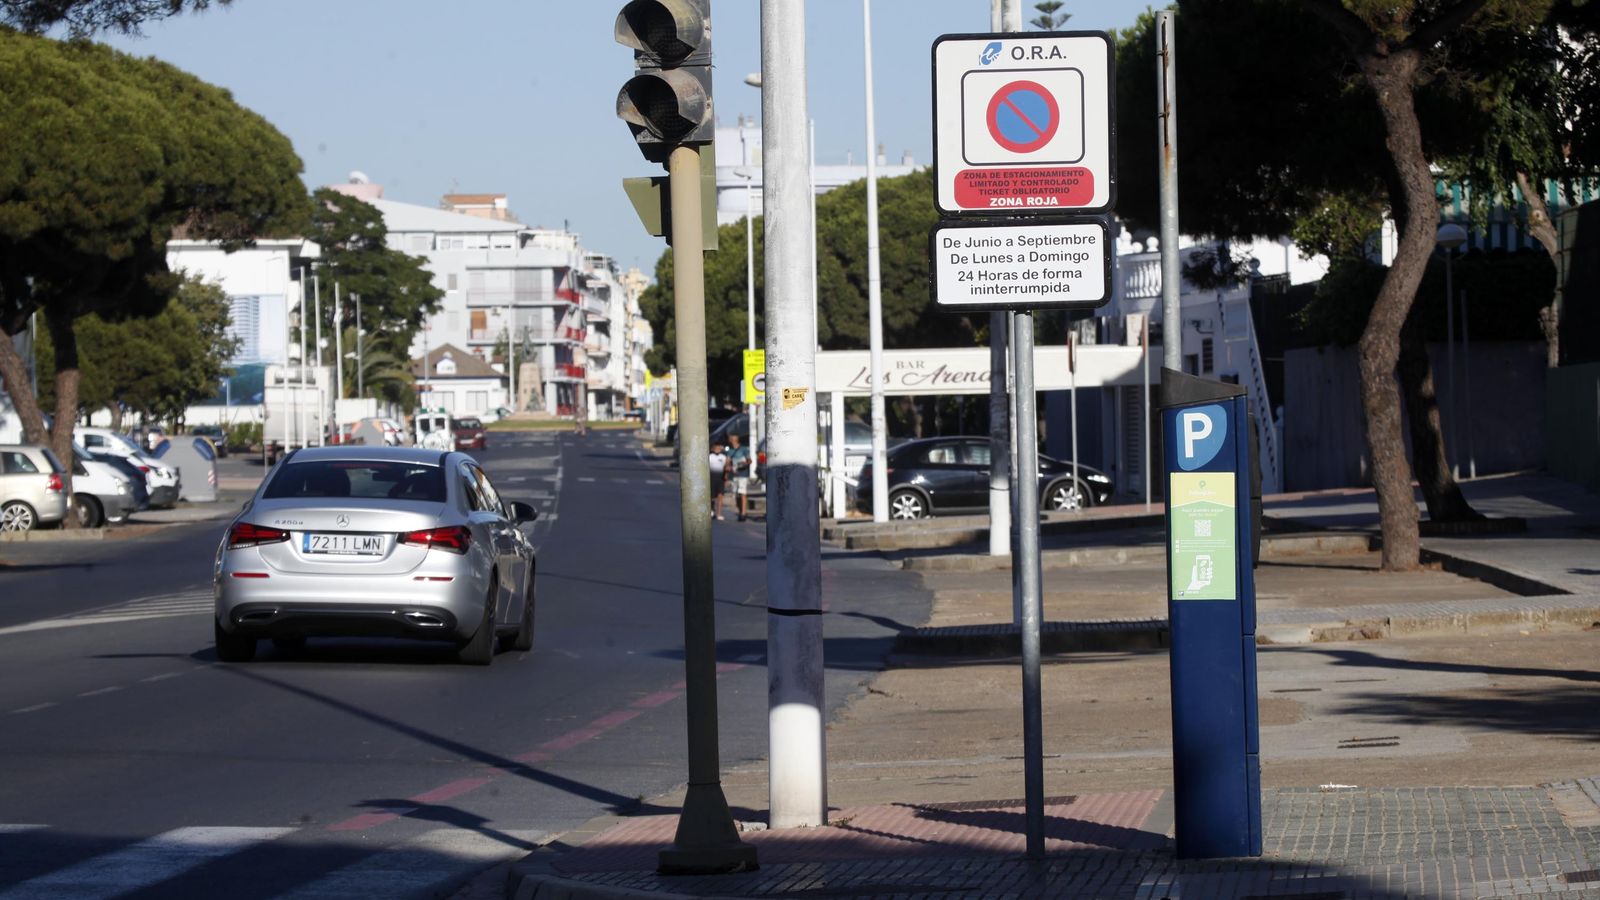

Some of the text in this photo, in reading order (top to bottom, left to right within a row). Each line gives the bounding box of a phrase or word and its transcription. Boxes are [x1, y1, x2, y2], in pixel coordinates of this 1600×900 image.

[1010, 45, 1067, 60] O.R.A.
[989, 171, 1001, 179] DE
[1003, 170, 1085, 178] ESTACIONAMIENTO
[969, 179, 1010, 187] LIMITADO
[1020, 178, 1079, 187] CONTROLADO
[979, 186, 1070, 195] TICKET OBLIGATORIO
[989, 196, 1059, 207] ZONA ROJA
[943, 234, 1096, 248] De Junio a Septiembre
[950, 251, 1089, 265] De Lunes a Domingo
[957, 268, 1082, 281] 24 Horas de forma
[970, 282, 1071, 296] ininterrumpida
[896, 360, 925, 369] BAR
[1183, 412, 1213, 458] P
[312, 536, 381, 550] 7211 LMN
